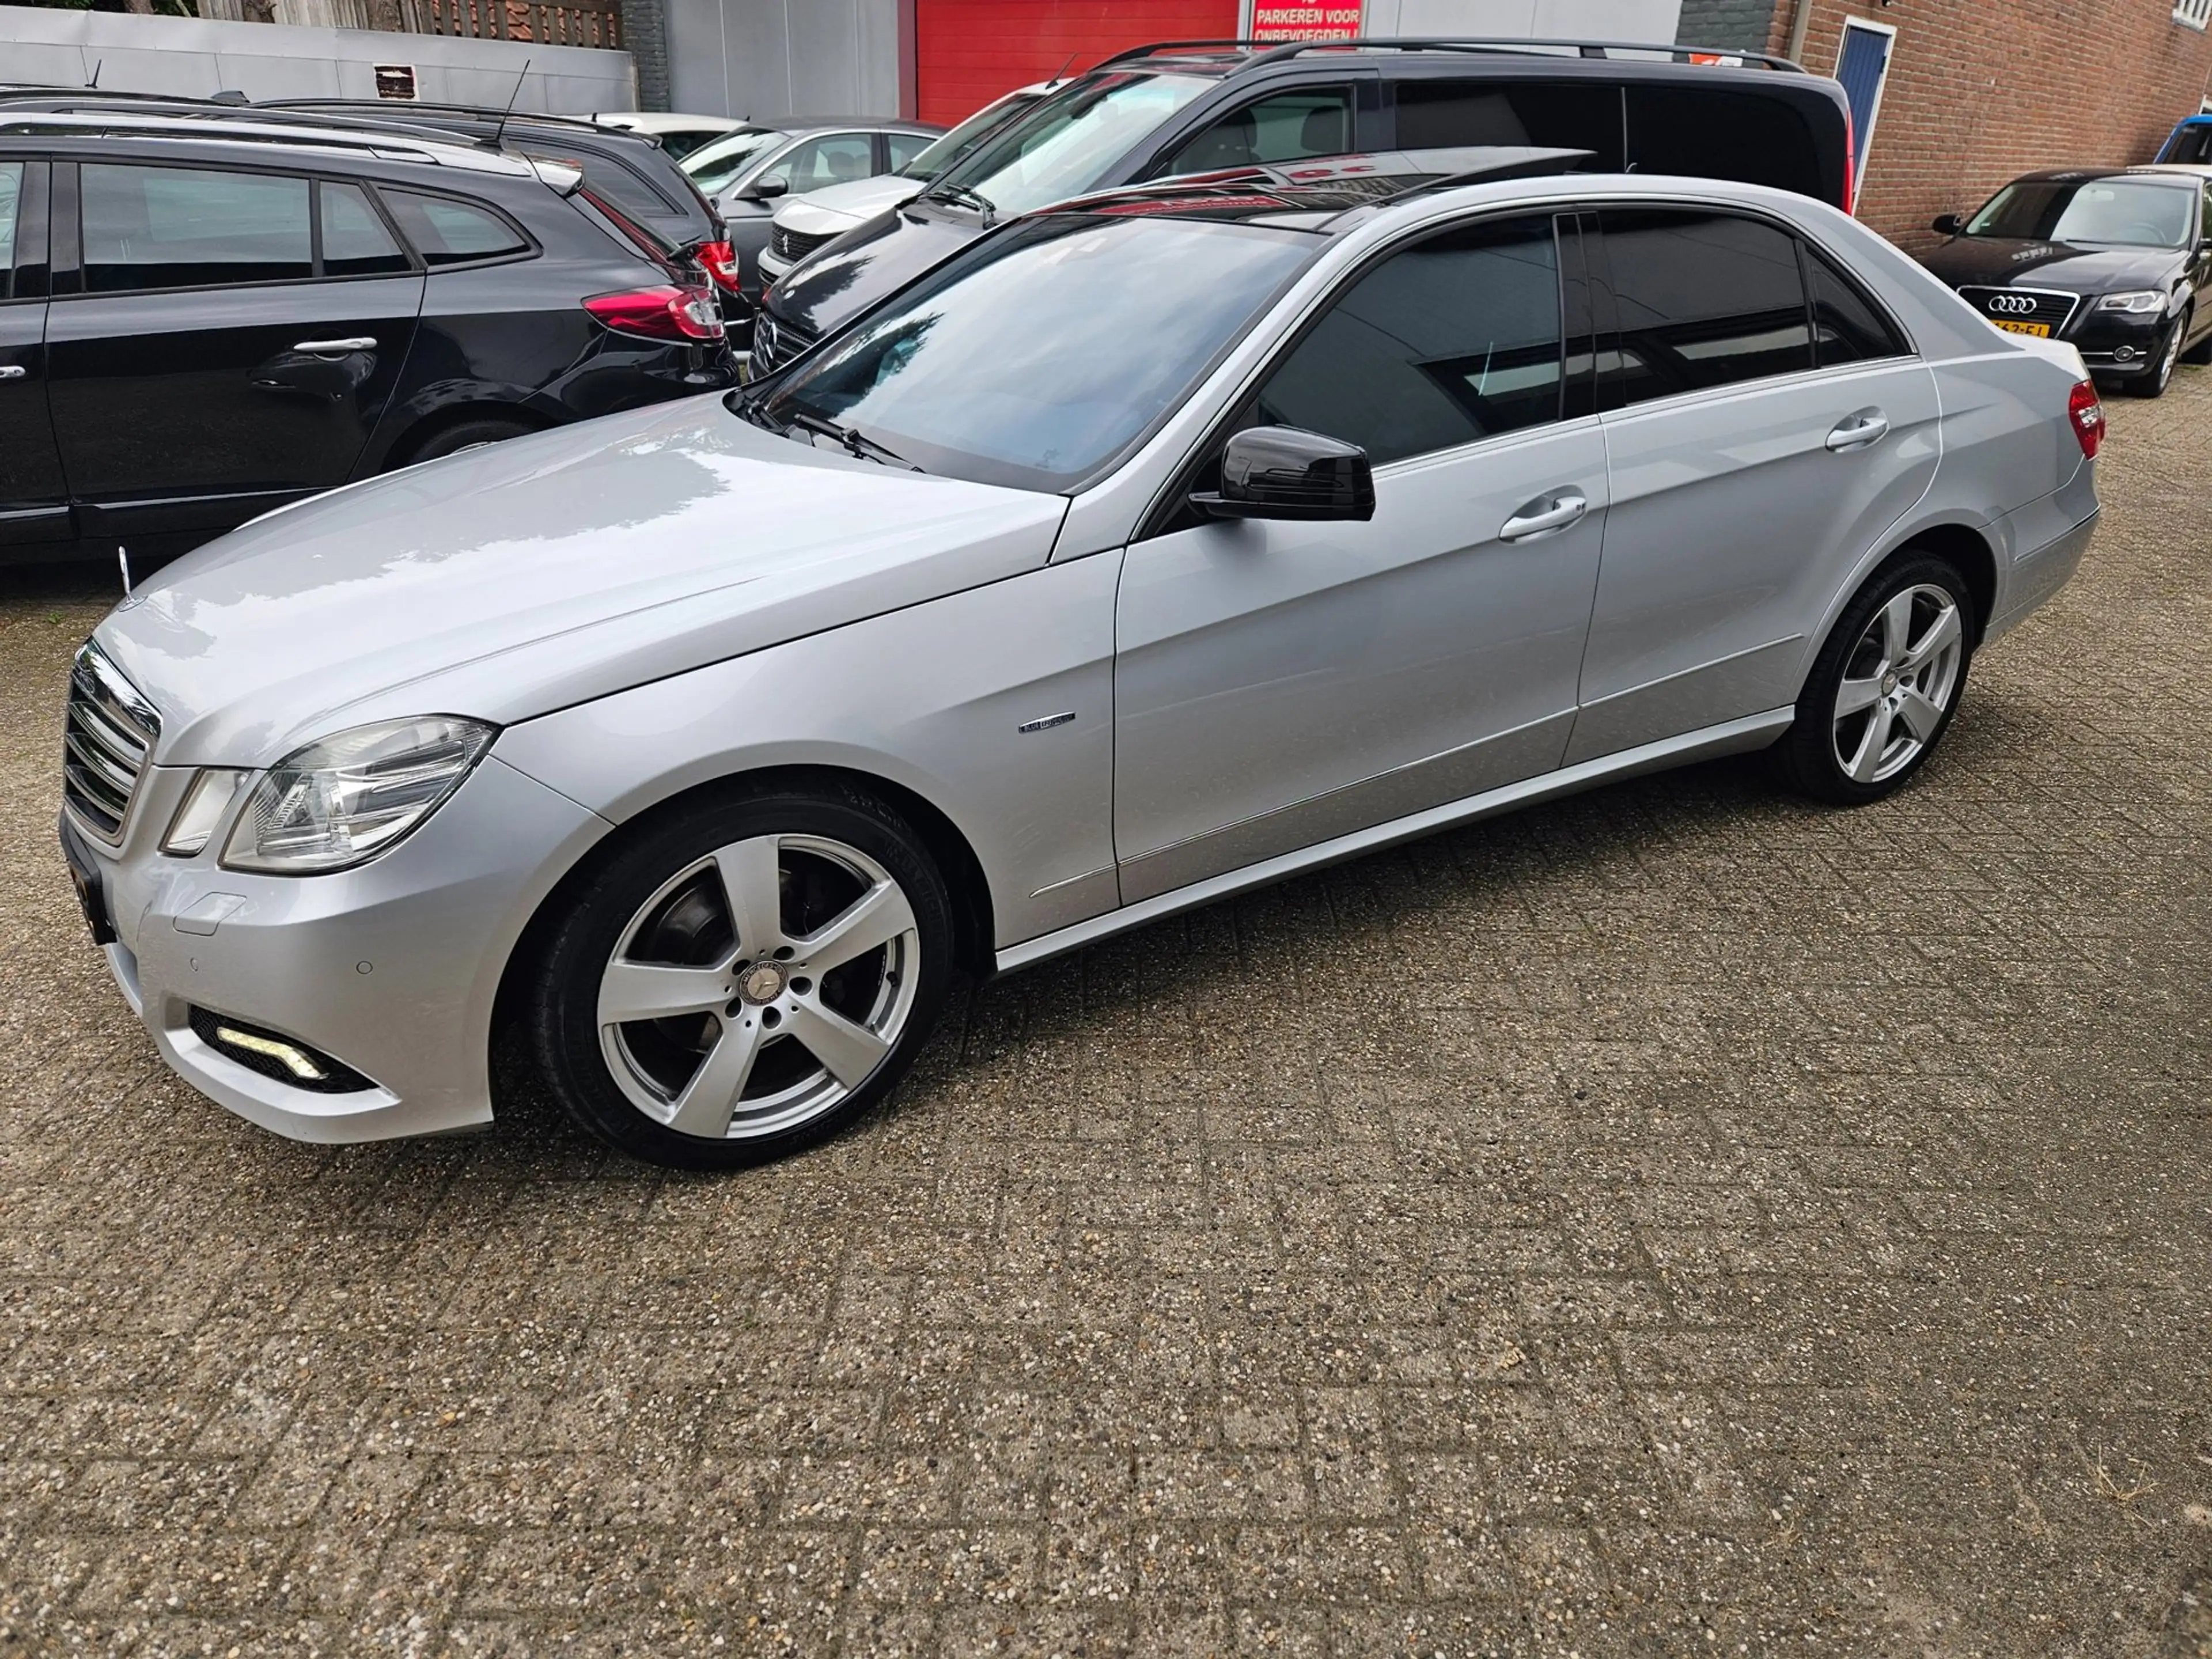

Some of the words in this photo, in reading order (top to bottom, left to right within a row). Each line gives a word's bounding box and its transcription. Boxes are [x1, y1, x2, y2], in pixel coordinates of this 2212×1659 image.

[1256, 9, 1324, 25] PARKEREN
[1325, 9, 1360, 24] VOOR
[1255, 29, 1350, 41] ONBEVOEGDEN
